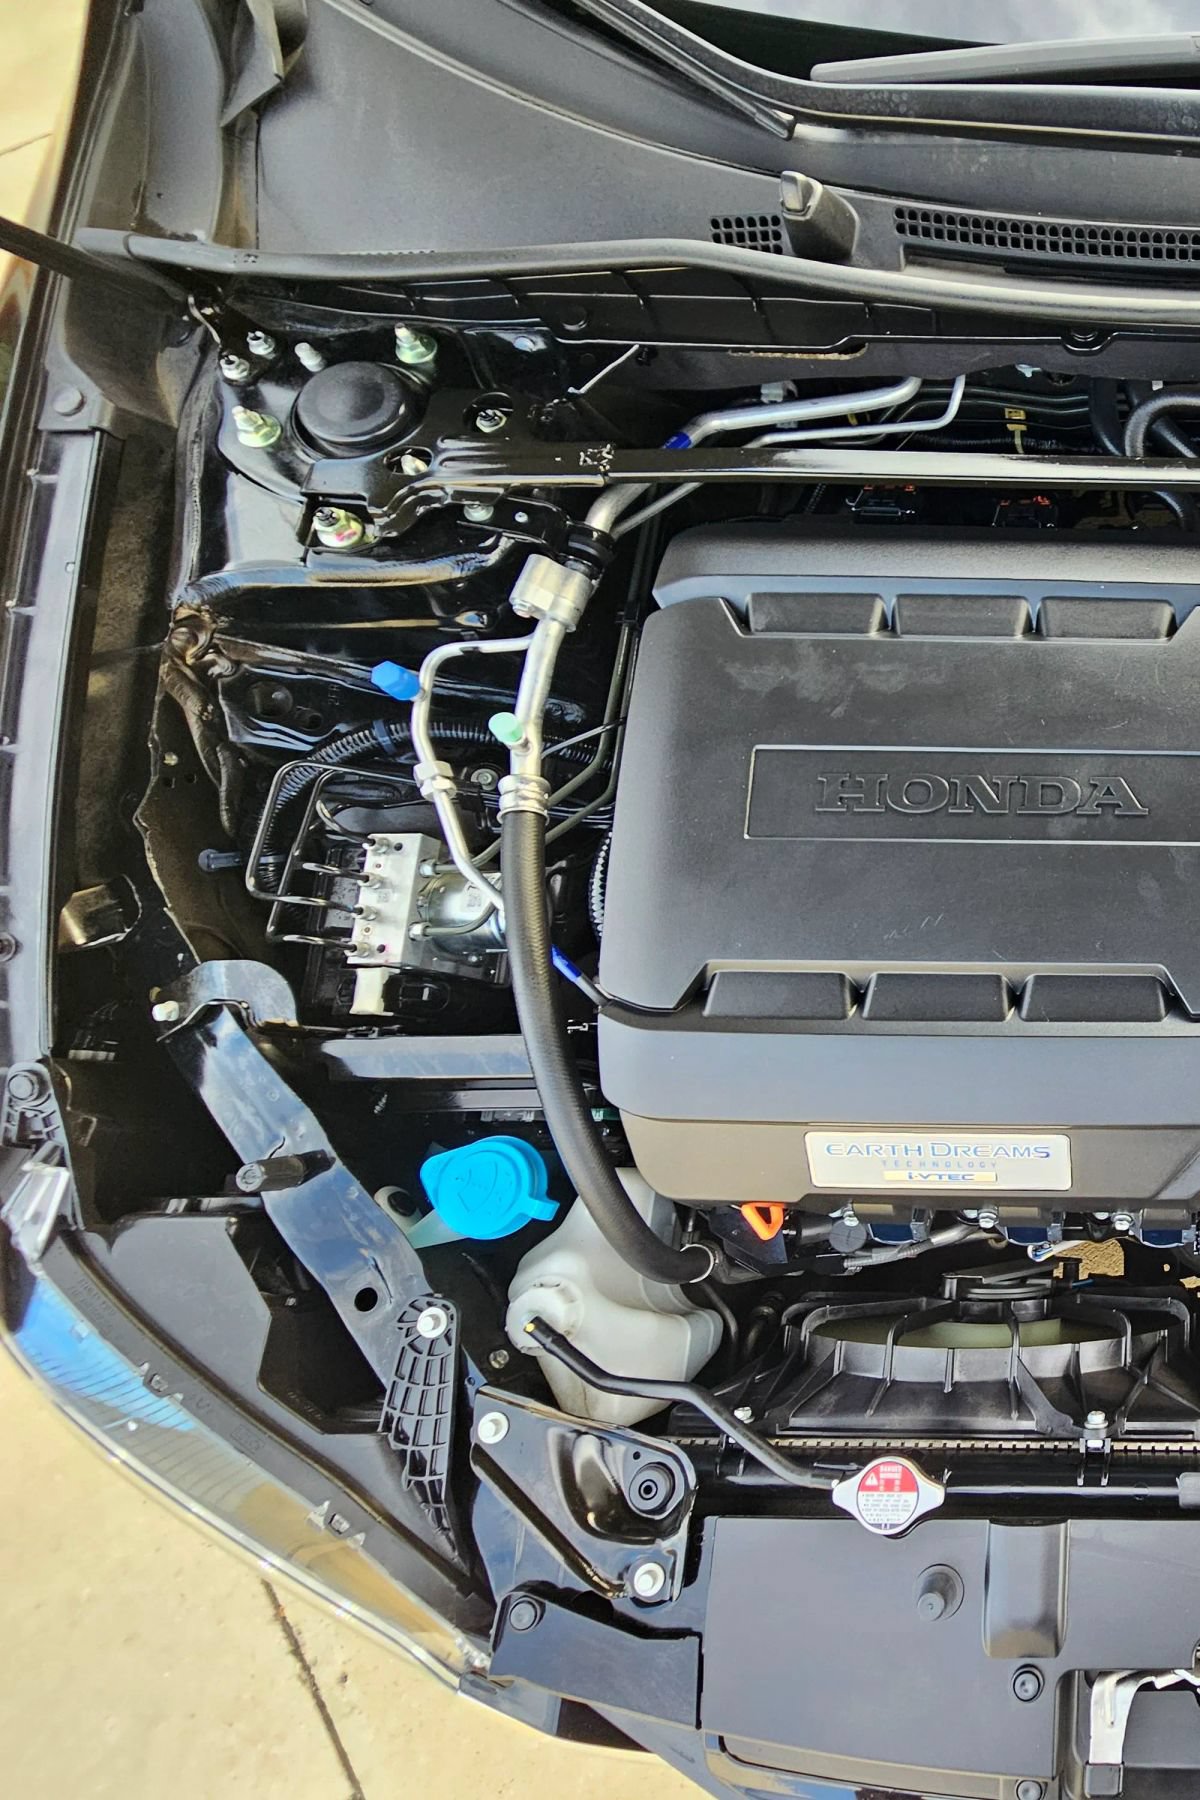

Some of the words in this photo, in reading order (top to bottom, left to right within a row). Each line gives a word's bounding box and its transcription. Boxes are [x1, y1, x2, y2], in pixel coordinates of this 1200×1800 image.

[814, 772, 1149, 816] HONDA
[826, 1142, 923, 1157] EARTH
[931, 1142, 1051, 1158] DREAMS
[882, 1160, 998, 1169] TECHNOLOGY
